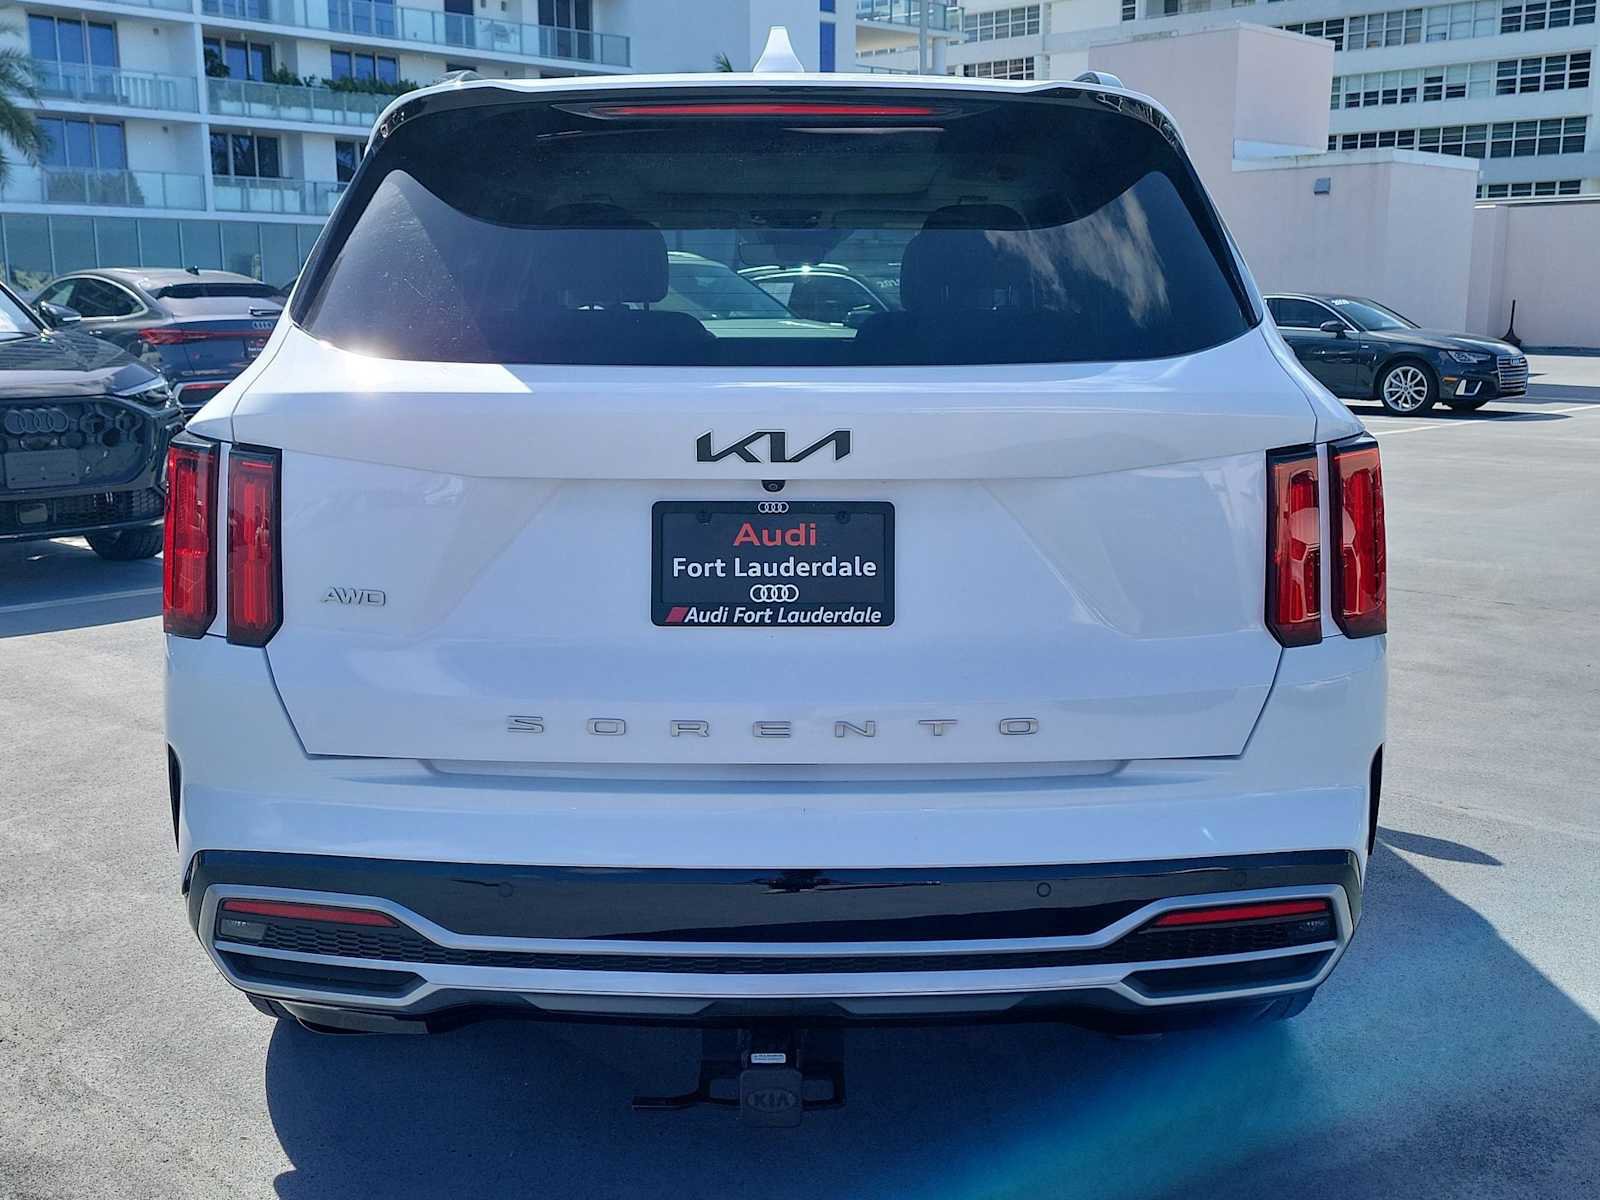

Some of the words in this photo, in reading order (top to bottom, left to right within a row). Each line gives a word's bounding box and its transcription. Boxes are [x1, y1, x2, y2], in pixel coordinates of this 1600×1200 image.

[696, 430, 852, 463] KIA
[733, 523, 817, 546] Audi
[672, 557, 726, 577] Fort
[734, 556, 877, 577] Lauderdale
[322, 584, 387, 605] AWD
[684, 606, 728, 623] Audi
[733, 607, 771, 623] Fort
[777, 606, 882, 624] Lauderdale
[507, 715, 1040, 738] SORENTO
